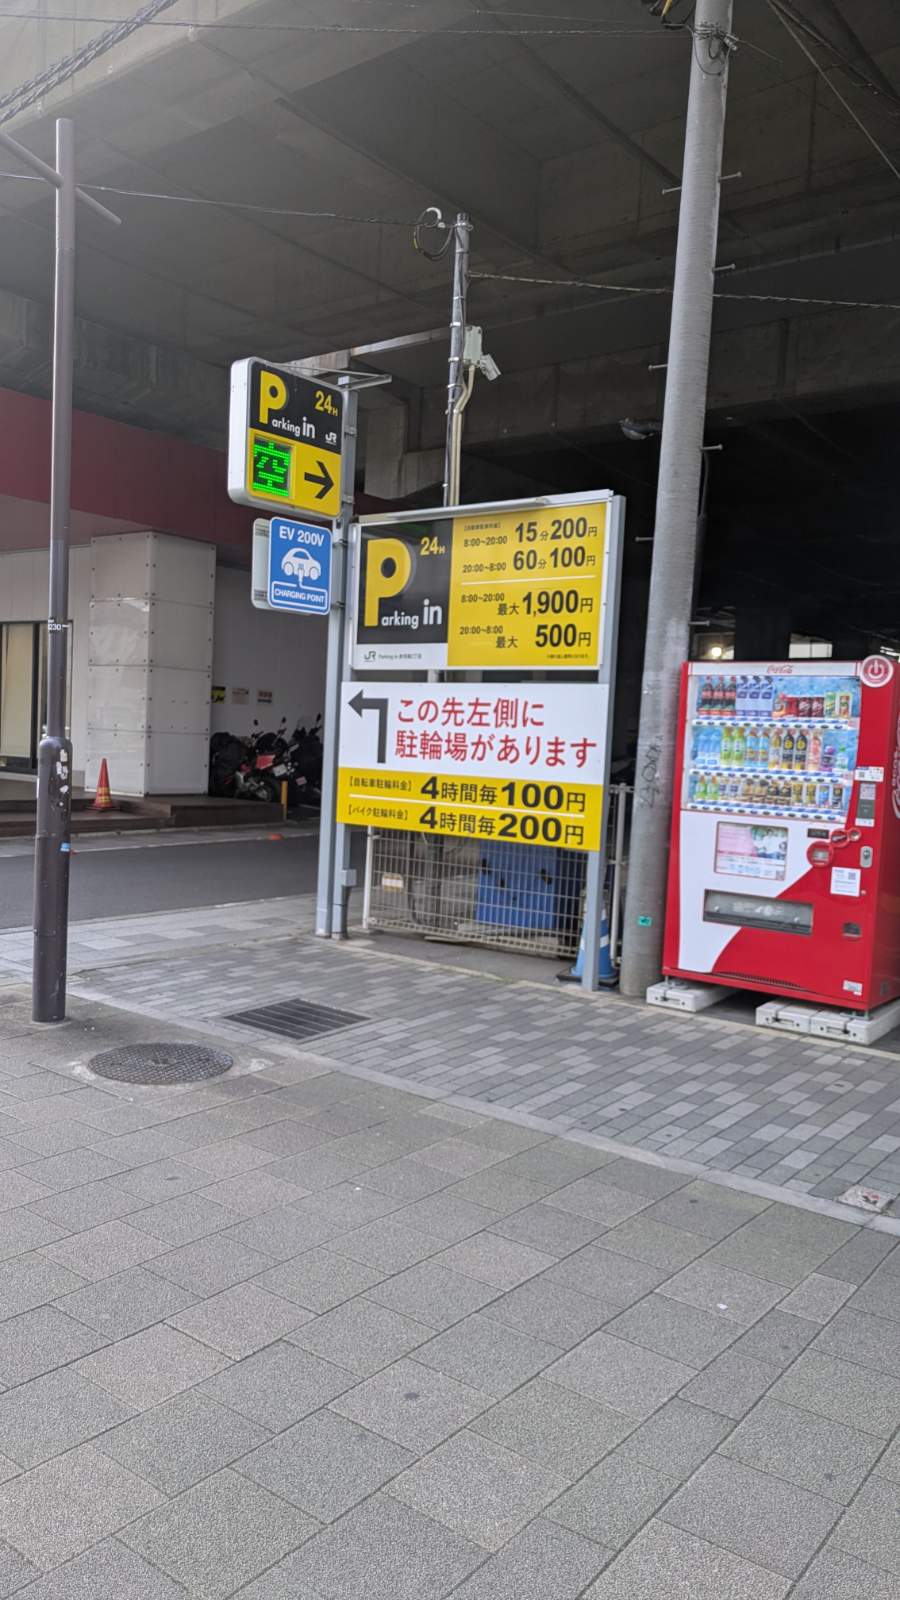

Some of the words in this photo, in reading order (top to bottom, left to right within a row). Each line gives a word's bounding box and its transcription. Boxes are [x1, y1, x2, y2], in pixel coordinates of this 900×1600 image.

[302, 416, 315, 438] in
[252, 442, 290, 497] 空
[279, 526, 295, 541] EV
[297, 530, 325, 547] 200V
[274, 588, 306, 600] CHARGING
[307, 594, 325, 604] POINT
[423, 599, 442, 625] in
[398, 697, 544, 728] この先左側に
[394, 730, 597, 768] 駐輪場があります
